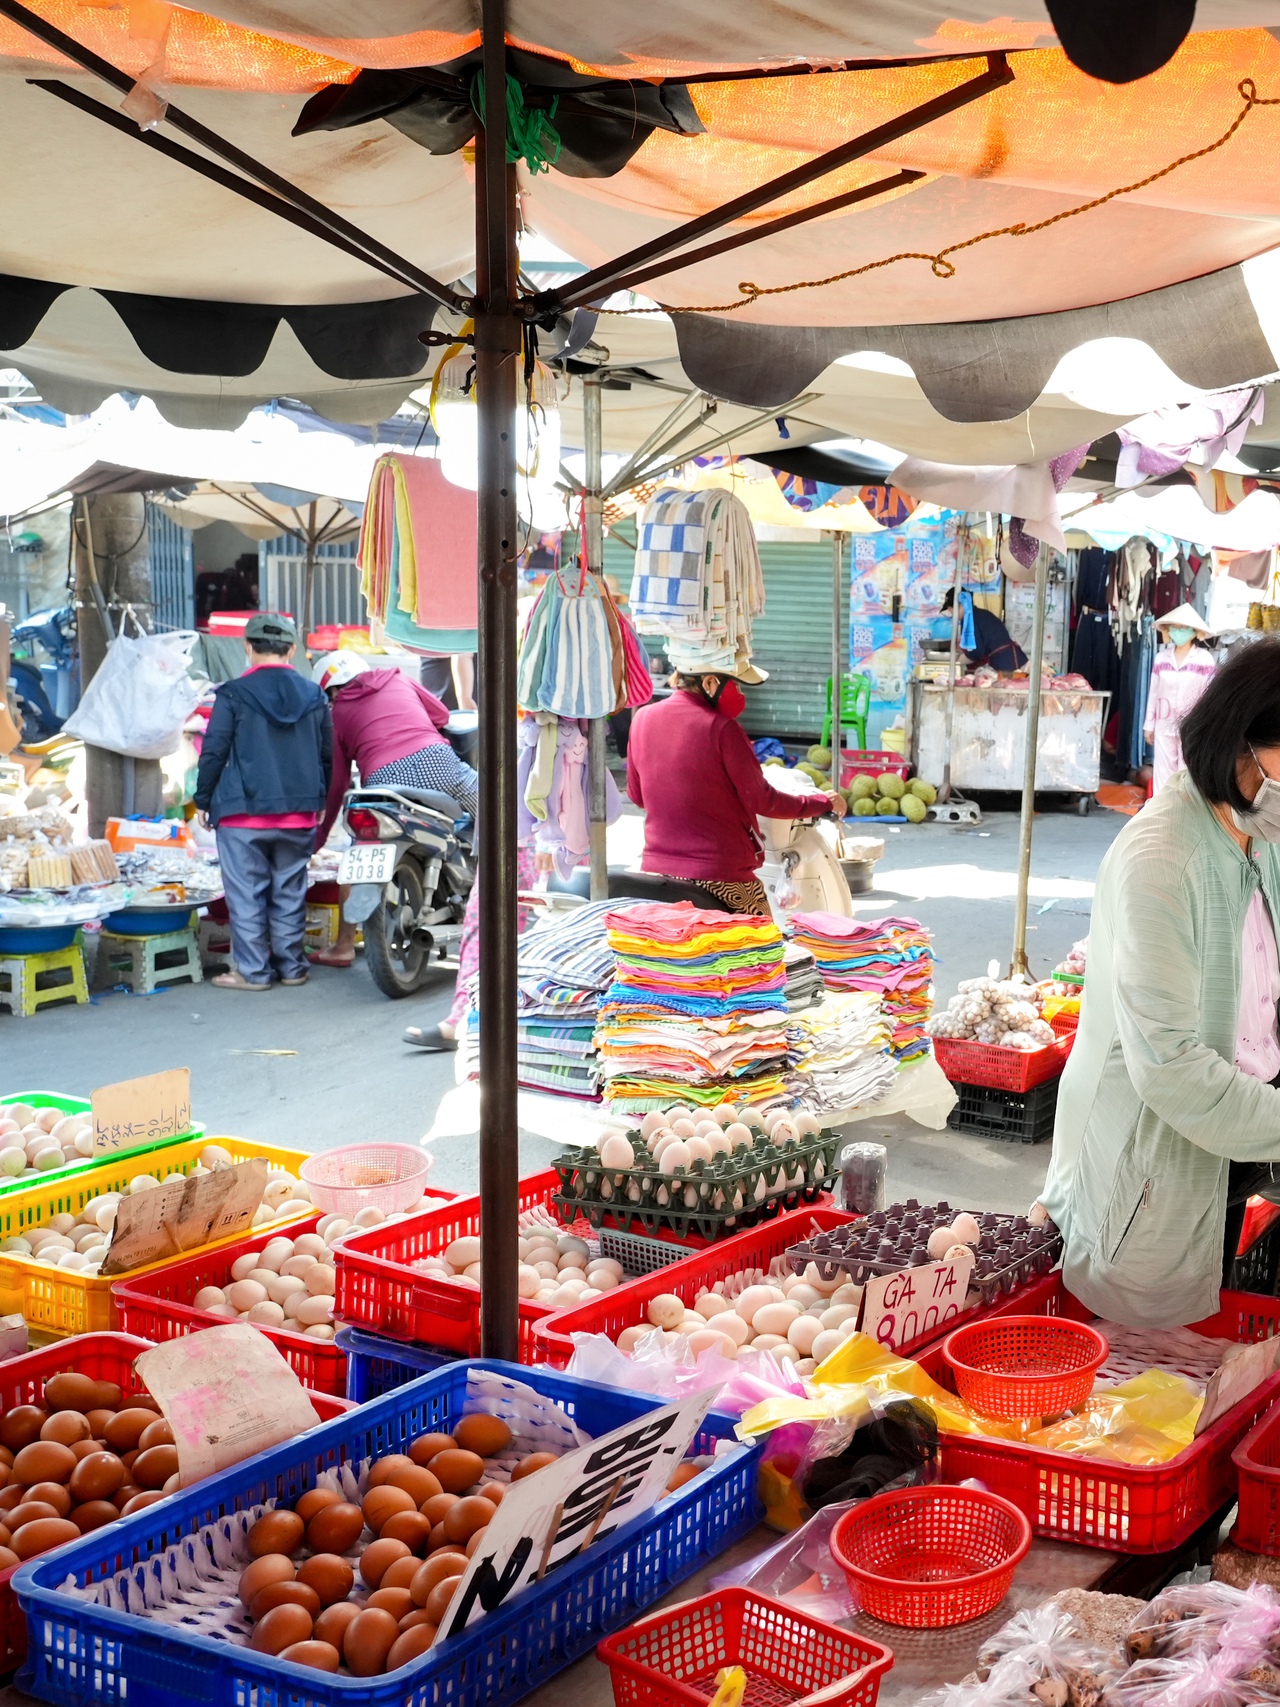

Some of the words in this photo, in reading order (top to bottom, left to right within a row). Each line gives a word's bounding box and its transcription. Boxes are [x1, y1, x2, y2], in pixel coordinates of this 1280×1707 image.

[349, 848, 387, 863] 54-P5
[346, 865, 384, 880] 3038
[883, 1273, 917, 1309] GÀ
[932, 1265, 957, 1298] TA
